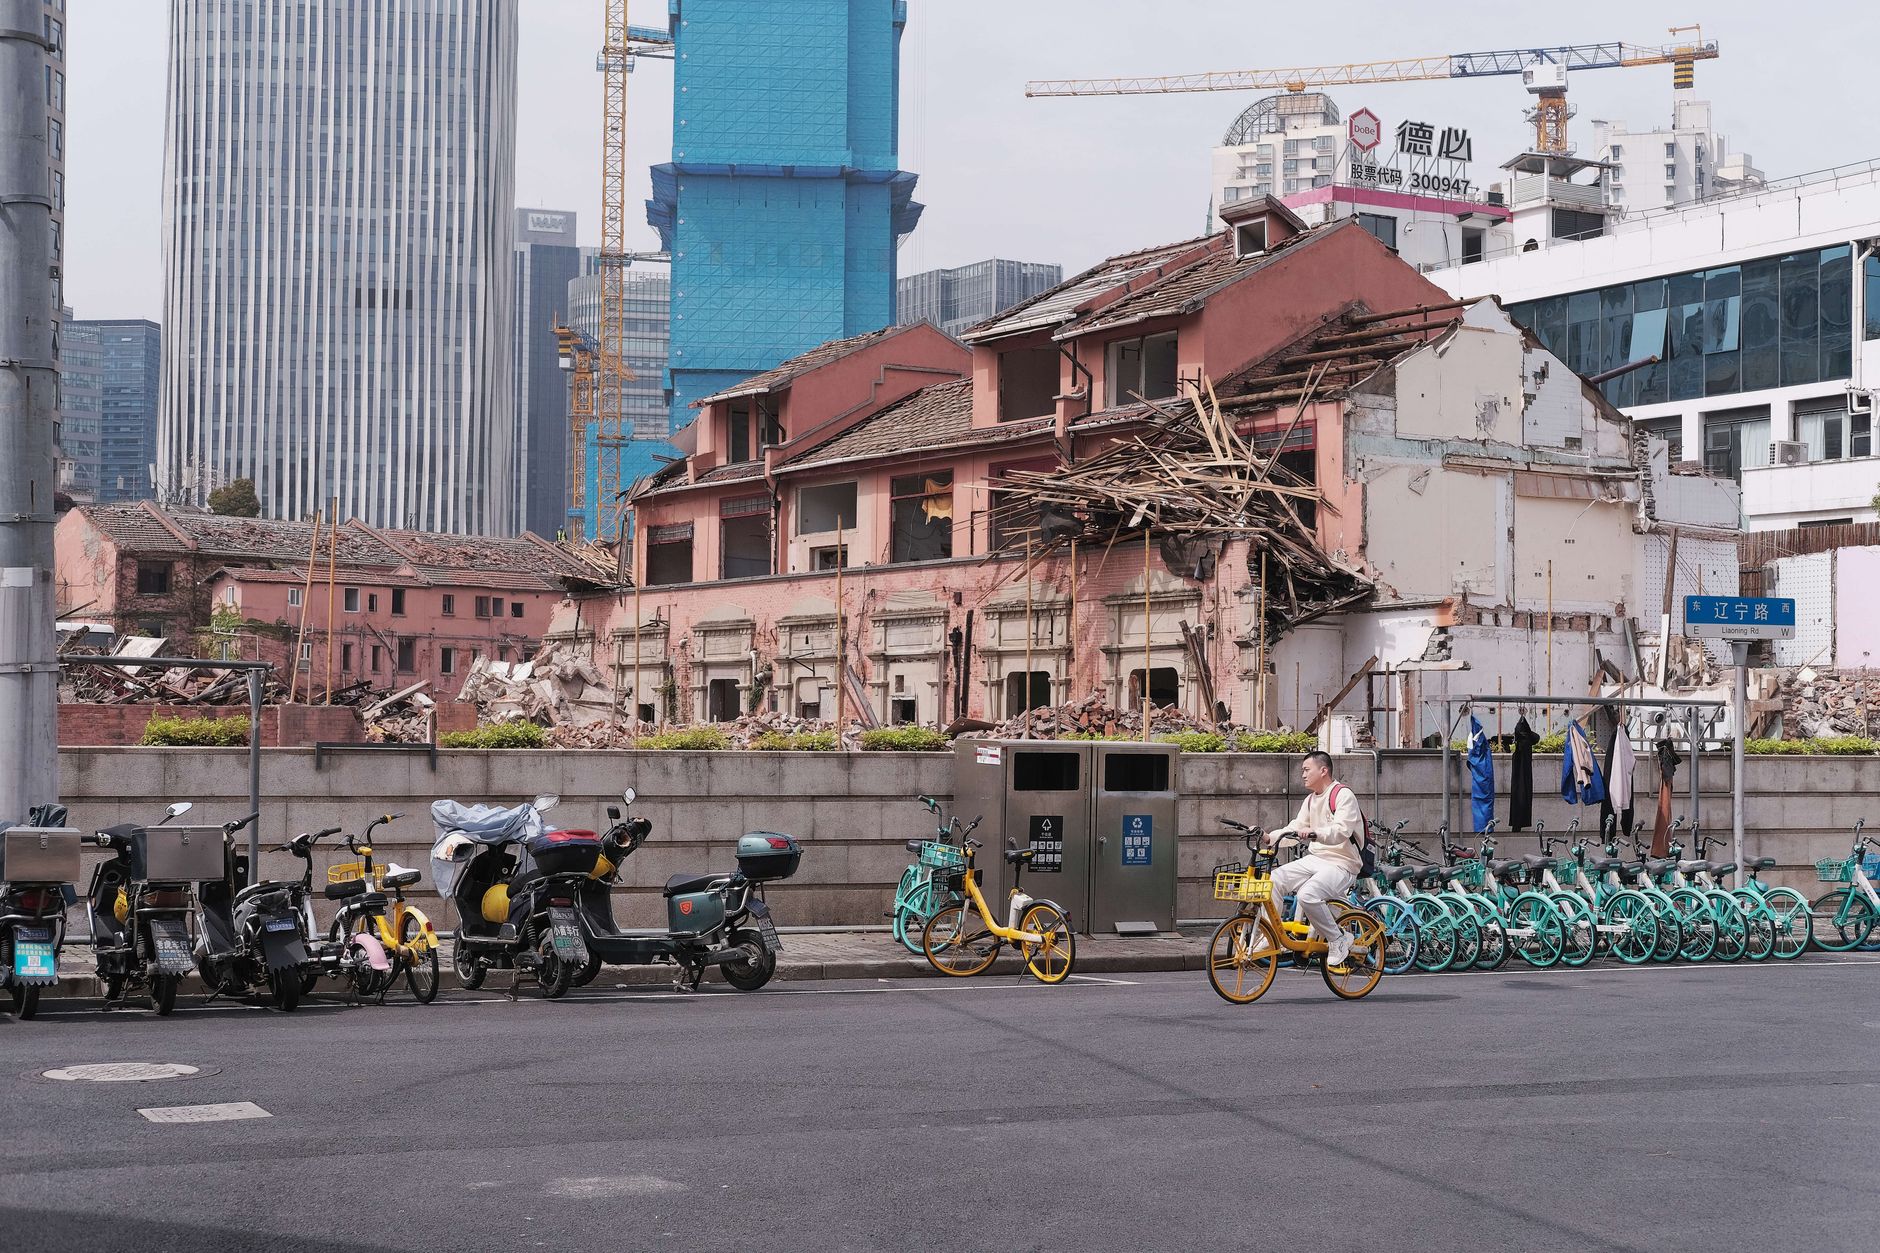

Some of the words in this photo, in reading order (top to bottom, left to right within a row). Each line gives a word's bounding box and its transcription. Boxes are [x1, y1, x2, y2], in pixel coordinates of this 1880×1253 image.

[1354, 124, 1376, 136] DoBe
[1396, 119, 1472, 163] 德必
[1350, 162, 1403, 186] 股票代码
[1410, 172, 1471, 195] 300947
[1692, 600, 1701, 612] 东
[1714, 601, 1769, 621] 辽宁路
[1781, 602, 1791, 614] 西
[1693, 625, 1700, 634] E
[1721, 626, 1748, 635] Liaoning
[1750, 627, 1760, 635] Rd
[1781, 628, 1790, 636] W
